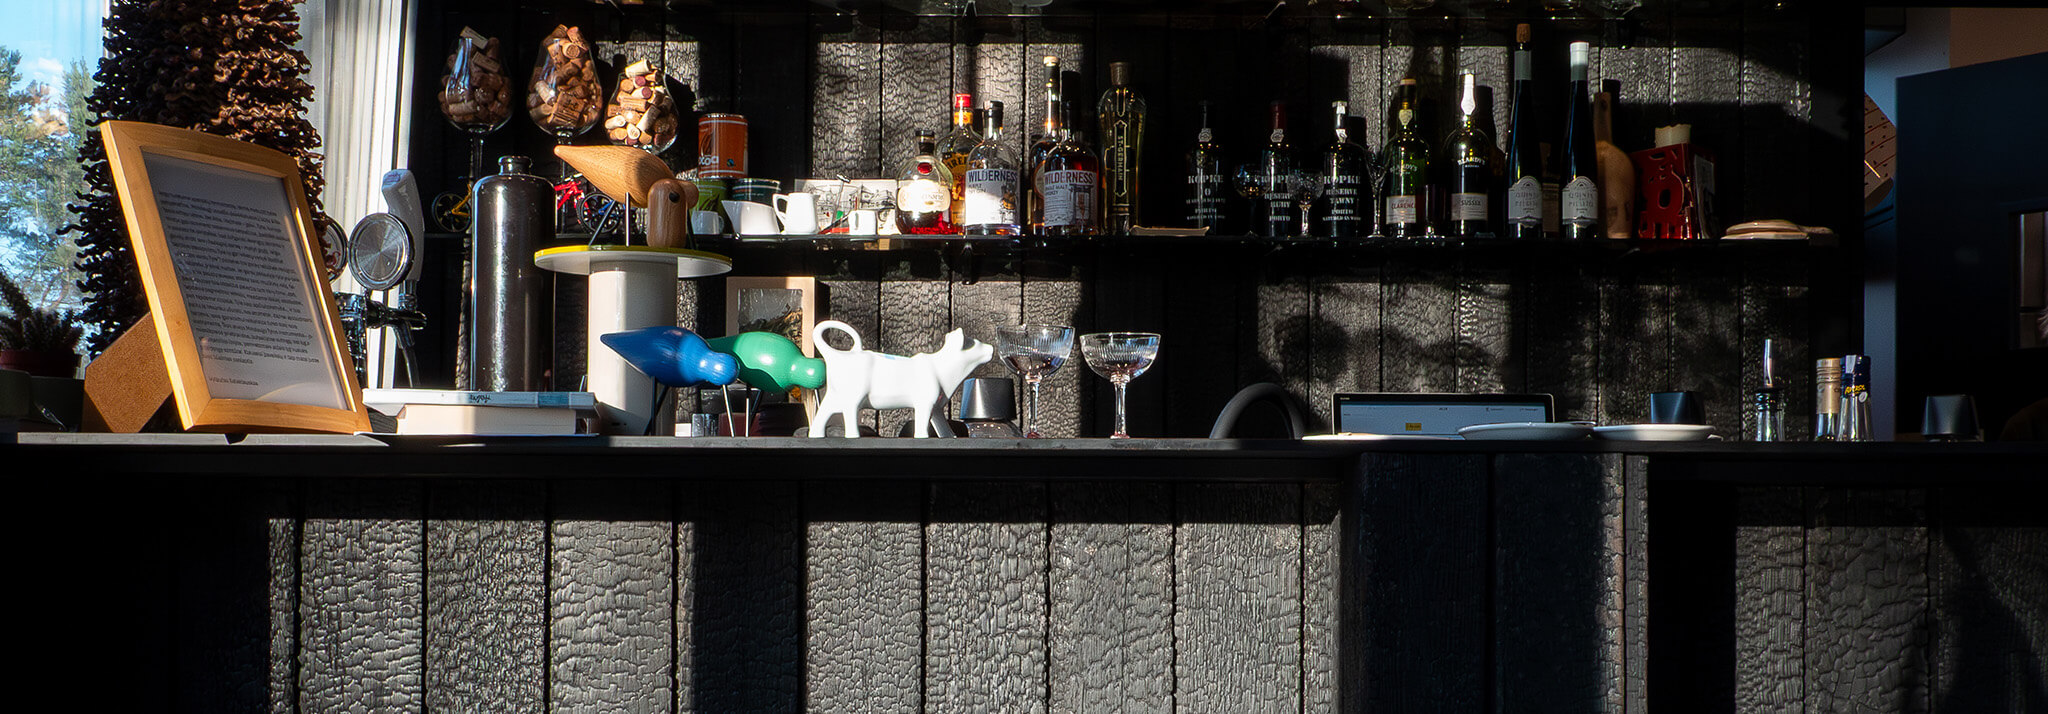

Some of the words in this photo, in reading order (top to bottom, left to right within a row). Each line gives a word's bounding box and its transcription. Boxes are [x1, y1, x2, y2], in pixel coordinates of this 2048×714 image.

[968, 170, 1018, 183] WILDERNESS
[1044, 171, 1094, 185] WILDERNESS
[1187, 174, 1225, 184] KOPKE
[1323, 175, 1361, 185] KOPKE
